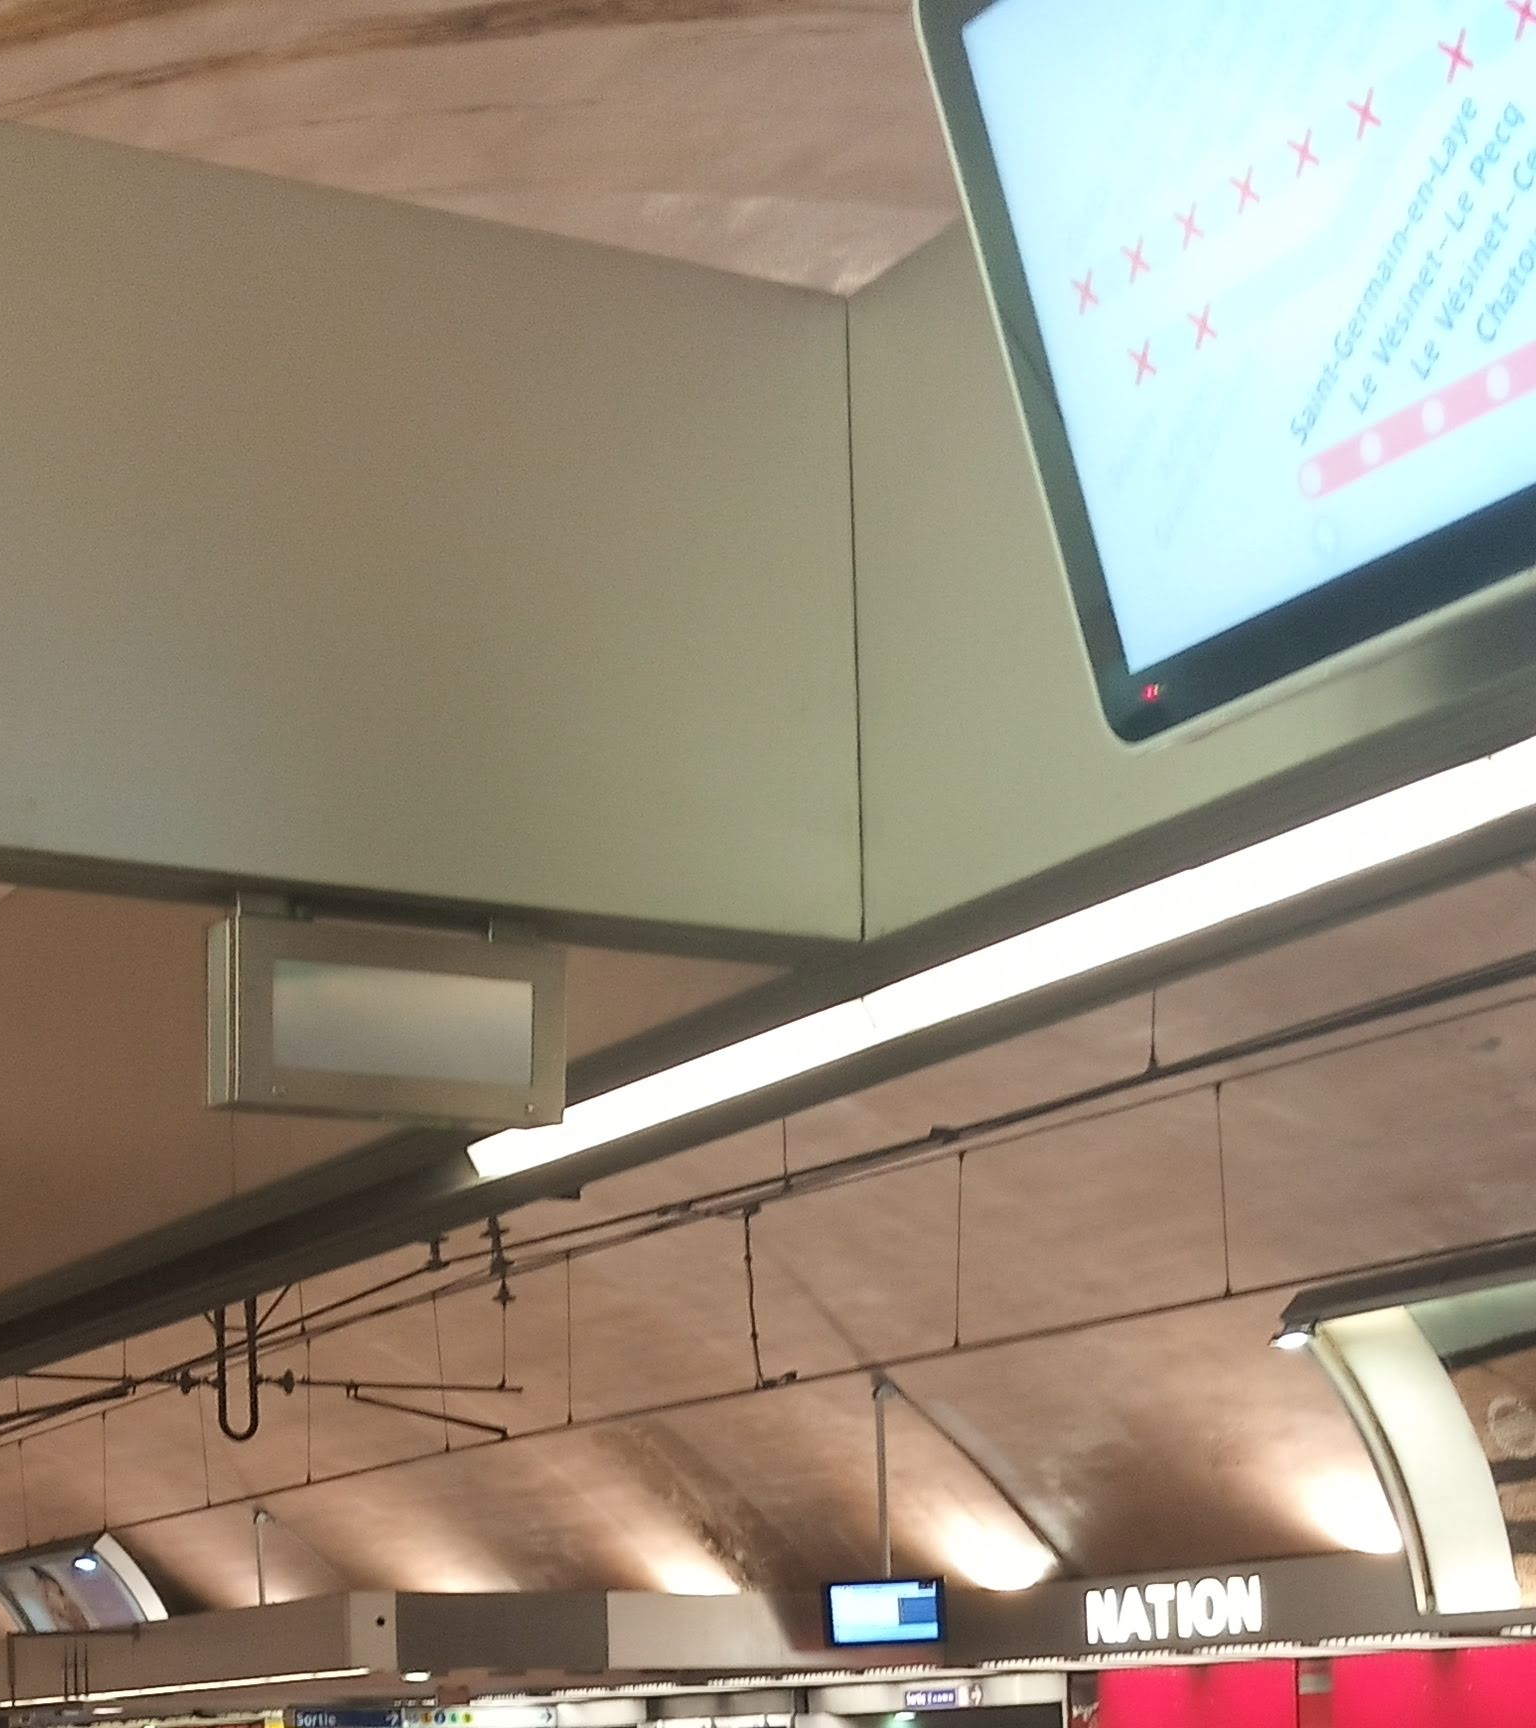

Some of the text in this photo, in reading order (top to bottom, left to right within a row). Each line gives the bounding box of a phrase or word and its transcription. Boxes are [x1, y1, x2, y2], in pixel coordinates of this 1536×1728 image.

[1349, 372, 1378, 416] Le
[1444, 189, 1474, 233] Le
[1469, 100, 1526, 188] Pecq
[1409, 339, 1441, 381] Le
[1085, 1574, 1263, 1645] NATION
[295, 1712, 337, 1728] Sortie
